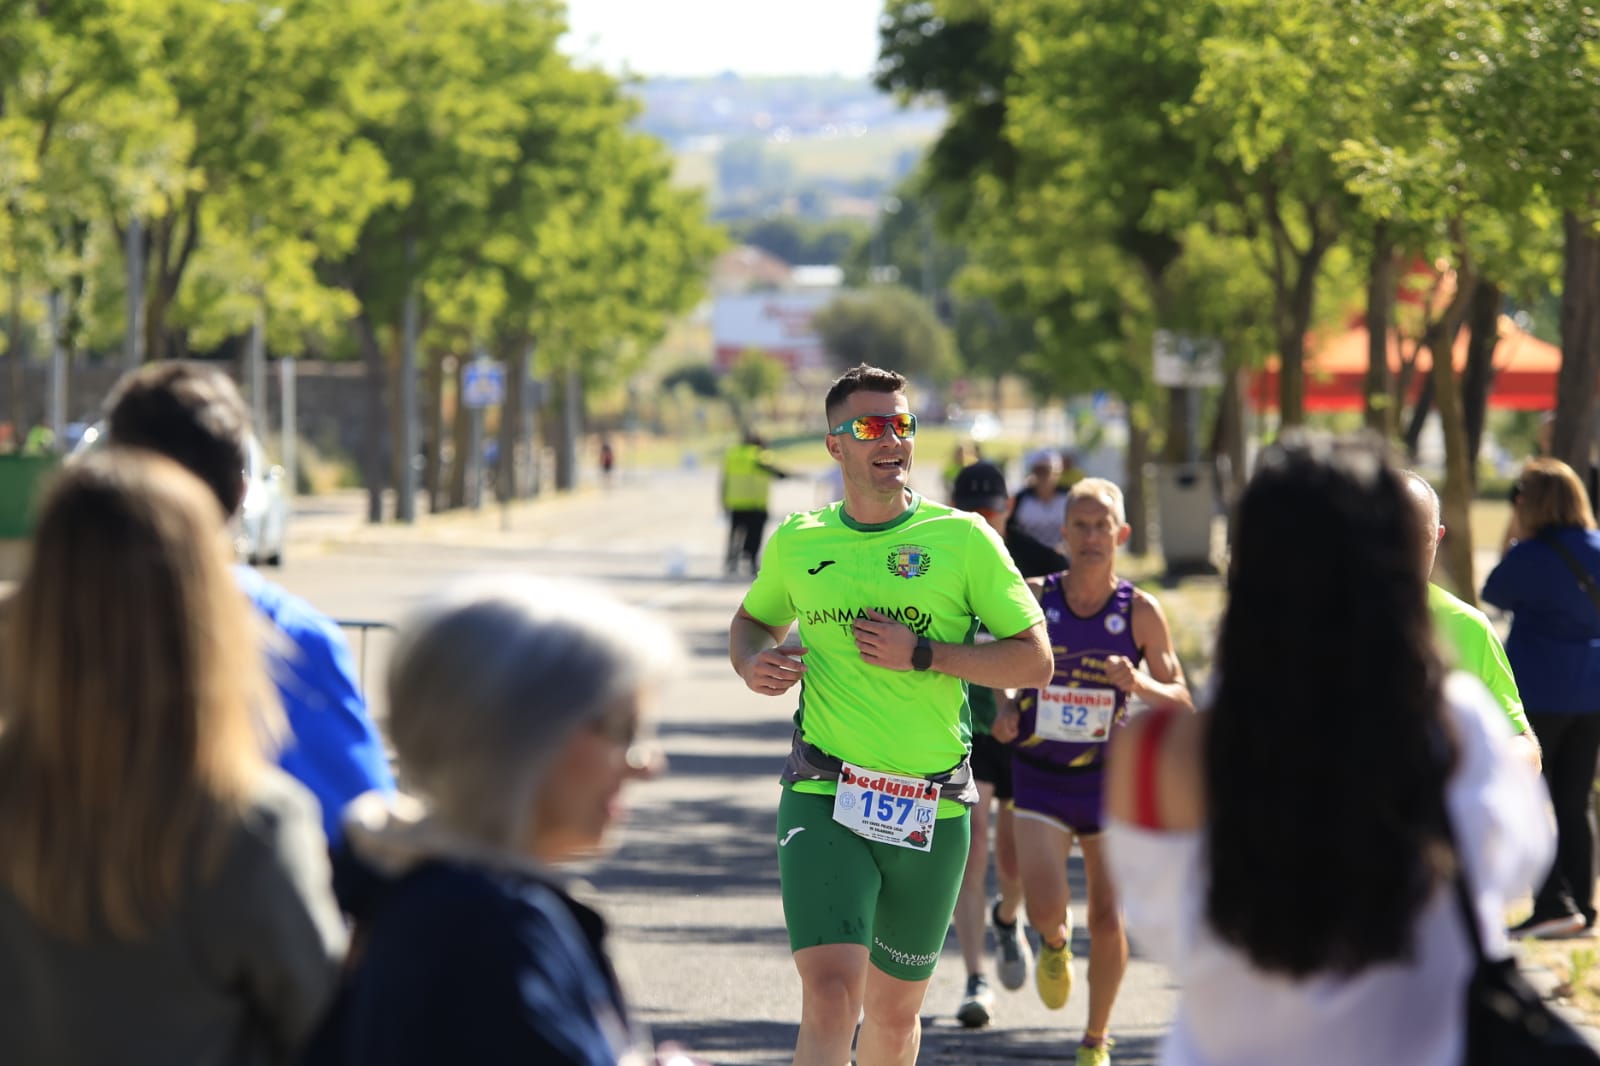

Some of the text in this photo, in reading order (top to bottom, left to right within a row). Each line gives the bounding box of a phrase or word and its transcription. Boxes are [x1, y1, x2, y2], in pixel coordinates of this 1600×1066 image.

[1041, 688, 1113, 706] bedunia
[1062, 705, 1088, 727] 52
[841, 766, 938, 802] bedunia
[861, 790, 914, 826] 157
